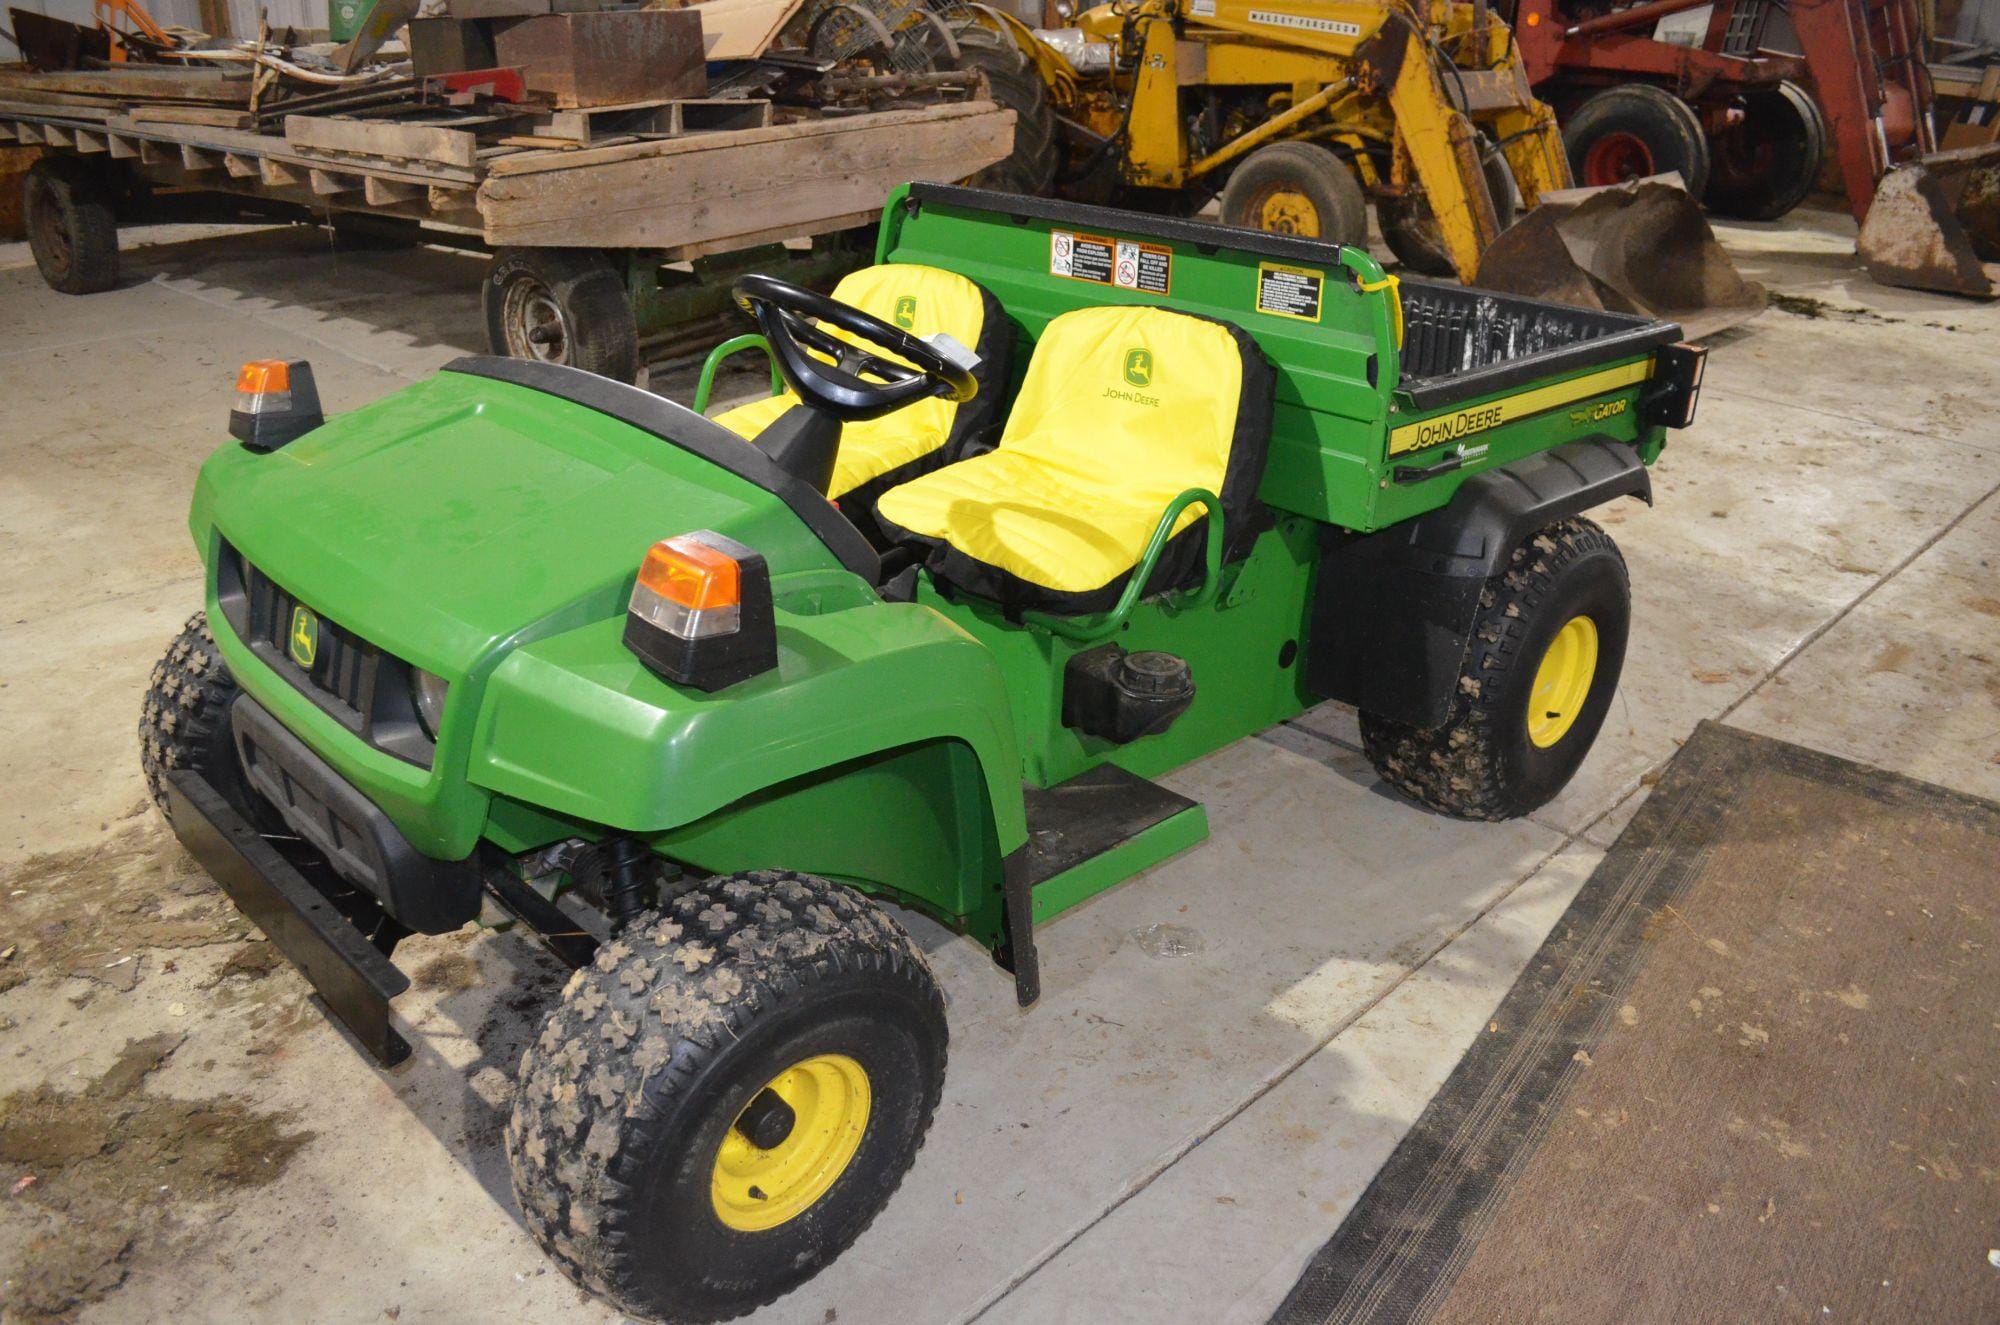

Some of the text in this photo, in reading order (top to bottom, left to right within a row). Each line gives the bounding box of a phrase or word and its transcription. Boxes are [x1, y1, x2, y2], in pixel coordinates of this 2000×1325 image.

[1251, 13, 1357, 33] MASSEY-FERGUSON
[1102, 387, 1160, 407] JOHN DEERE
[1594, 399, 1627, 421] GATOR
[1410, 406, 1503, 448] JOHN DEERE
